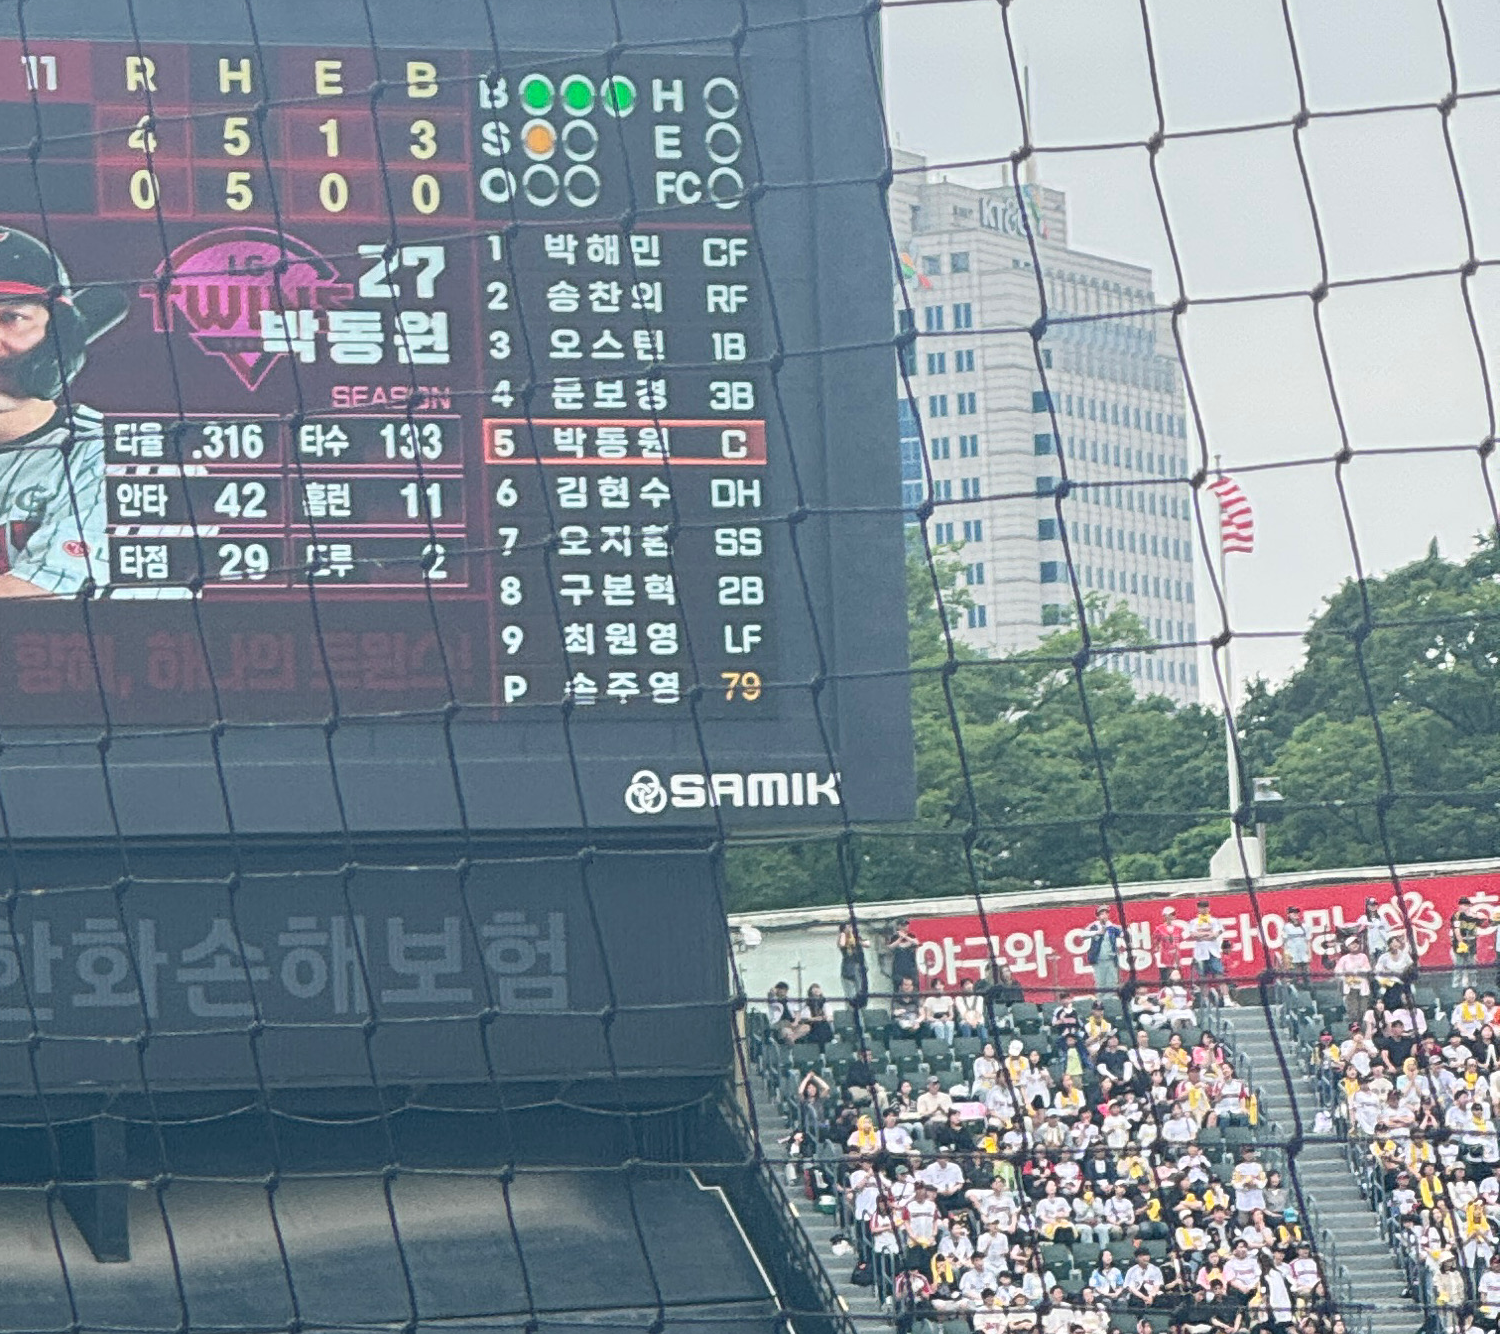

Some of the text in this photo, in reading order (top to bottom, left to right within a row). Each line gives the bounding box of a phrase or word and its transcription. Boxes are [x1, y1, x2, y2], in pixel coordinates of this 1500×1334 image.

[21, 55, 57, 90] 11
[127, 57, 156, 93] R
[219, 59, 251, 94] H
[315, 60, 342, 95] E
[407, 62, 438, 98] B
[652, 78, 684, 112] H
[223, 118, 251, 157] 5
[319, 119, 337, 157] 1
[411, 120, 437, 159] 3
[481, 122, 680, 159] S E
[225, 171, 252, 211] 5
[319, 172, 347, 212] 0
[411, 175, 440, 214] 0
[656, 172, 701, 204] FC
[488, 234, 747, 266] 1 박해민 CF
[358, 245, 445, 299] 27
[487, 282, 508, 310] 2
[707, 285, 748, 313] RF
[259, 310, 450, 365] 박동원
[489, 329, 746, 361] 3 오스틴 1B
[491, 380, 514, 408] 4
[709, 382, 754, 410] 3B
[192, 424, 264, 460] .316
[301, 424, 350, 457] 타수
[380, 423, 442, 459] 133
[493, 427, 747, 458] 5 박동원 C
[117, 483, 168, 519] 안타
[215, 483, 267, 519] 42
[401, 483, 442, 518] 11
[496, 476, 761, 508] 6 김현수 DH
[499, 528, 518, 555] 7
[715, 528, 762, 556] SS
[119, 544, 169, 579] 타점
[219, 544, 269, 580] 29
[422, 544, 447, 579] 2
[500, 574, 764, 606] 8 구본혁 2B
[502, 622, 762, 655] 9 최원영 LF
[504, 675, 527, 703] P
[721, 672, 761, 700] 79
[670, 772, 841, 808] SAMIK
[917, 928, 1052, 986] 야구와
